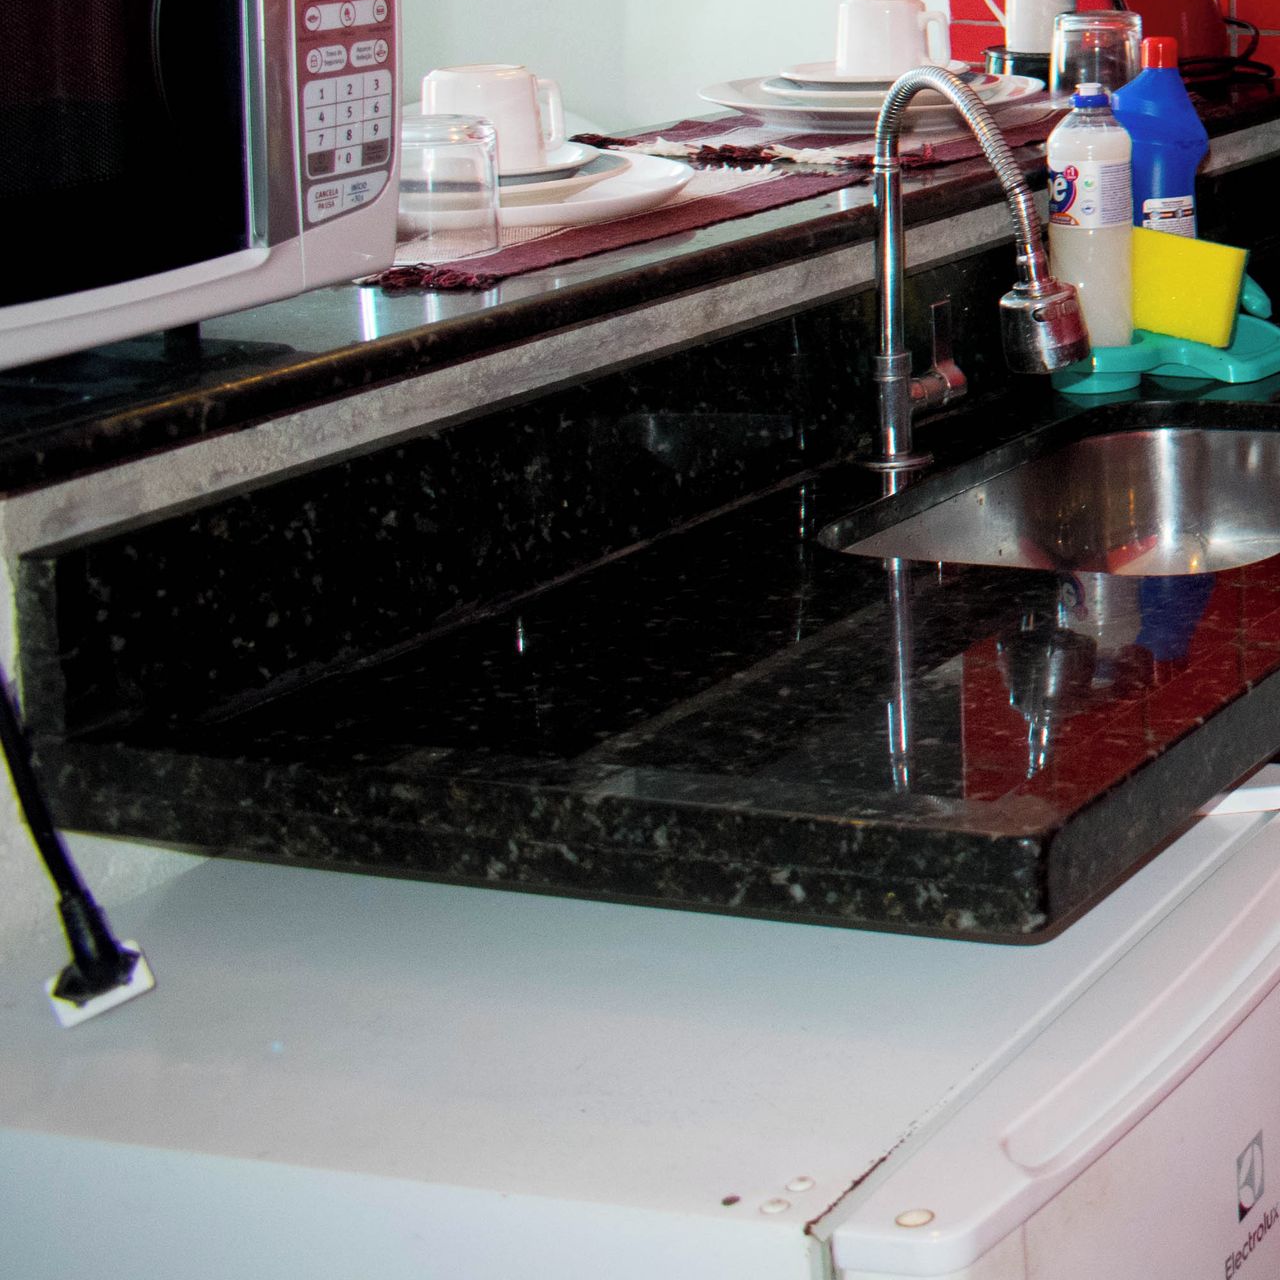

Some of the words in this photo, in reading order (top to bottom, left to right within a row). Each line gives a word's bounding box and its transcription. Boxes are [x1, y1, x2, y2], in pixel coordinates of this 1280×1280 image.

[319, 87, 324, 100] 1
[346, 83, 353, 95] 2
[374, 78, 379, 91] 3
[318, 111, 325, 123] 4
[347, 106, 353, 118] 5
[373, 101, 379, 113] 6
[318, 134, 324, 146] 7
[346, 129, 353, 141] 8
[373, 123, 379, 136] 9
[346, 152, 352, 164] 0
[315, 188, 339, 200] CANCELA
[317, 200, 335, 210] PAUSA
[1224, 1201, 1280, 1280] Electrolux
